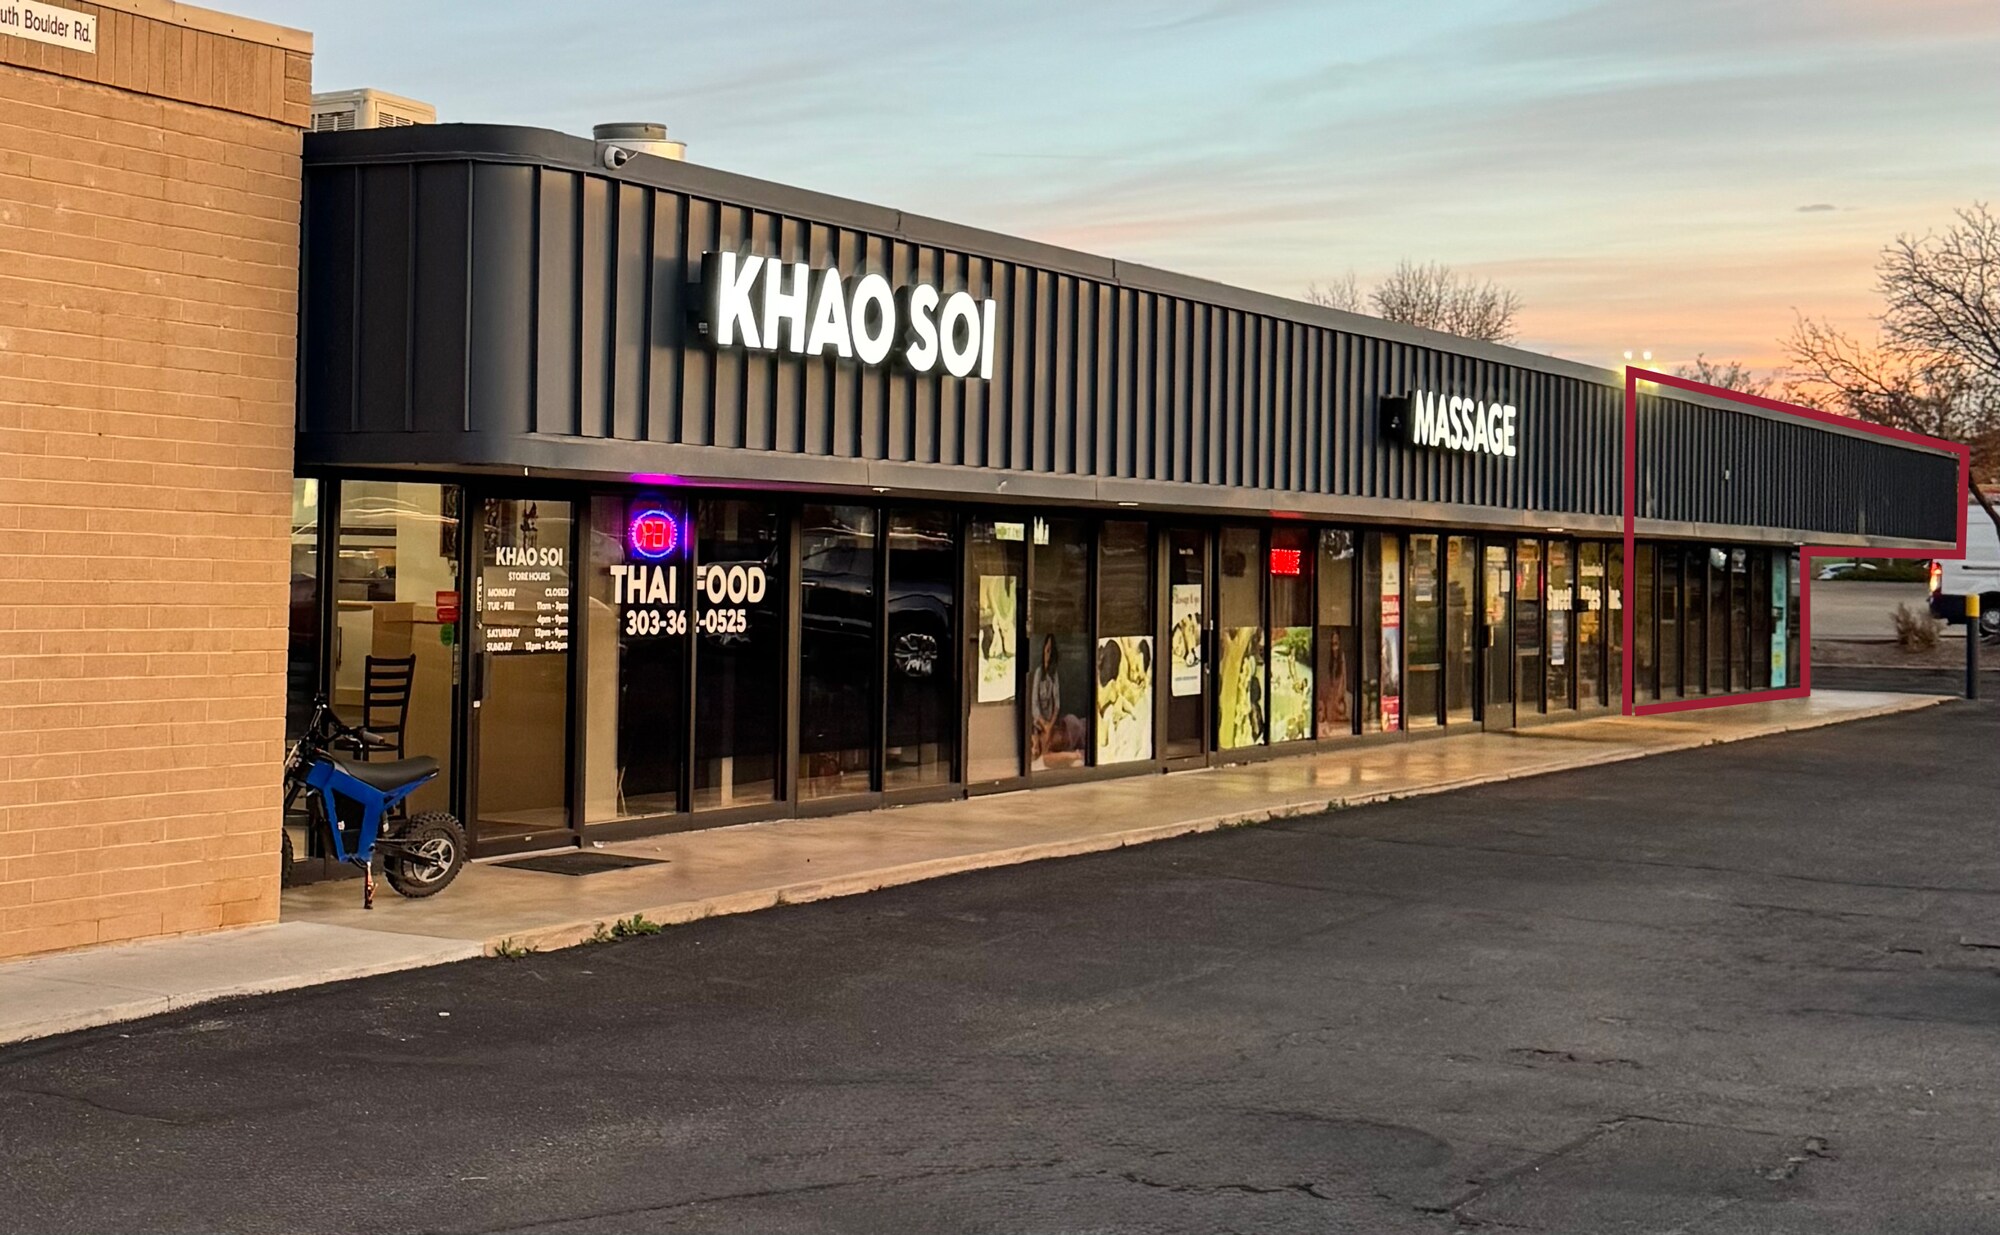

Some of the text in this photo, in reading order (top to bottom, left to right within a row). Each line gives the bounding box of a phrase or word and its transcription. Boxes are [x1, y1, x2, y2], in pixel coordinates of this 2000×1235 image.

[25, 9, 69, 37] Boulder
[74, 20, 92, 43] Rd.
[718, 251, 996, 380] KHAO SOI
[1414, 389, 1517, 457] MASSAGE
[495, 546, 563, 567] KHAO SOI
[508, 571, 551, 582] STORE HOURS
[610, 564, 766, 604] THAI FOOD
[487, 587, 569, 598] MONDAY CLOSED
[486, 601, 500, 611] TUE
[503, 601, 515, 611] FRI
[486, 628, 521, 638] SATURDAY
[486, 642, 513, 652] SUNDAY
